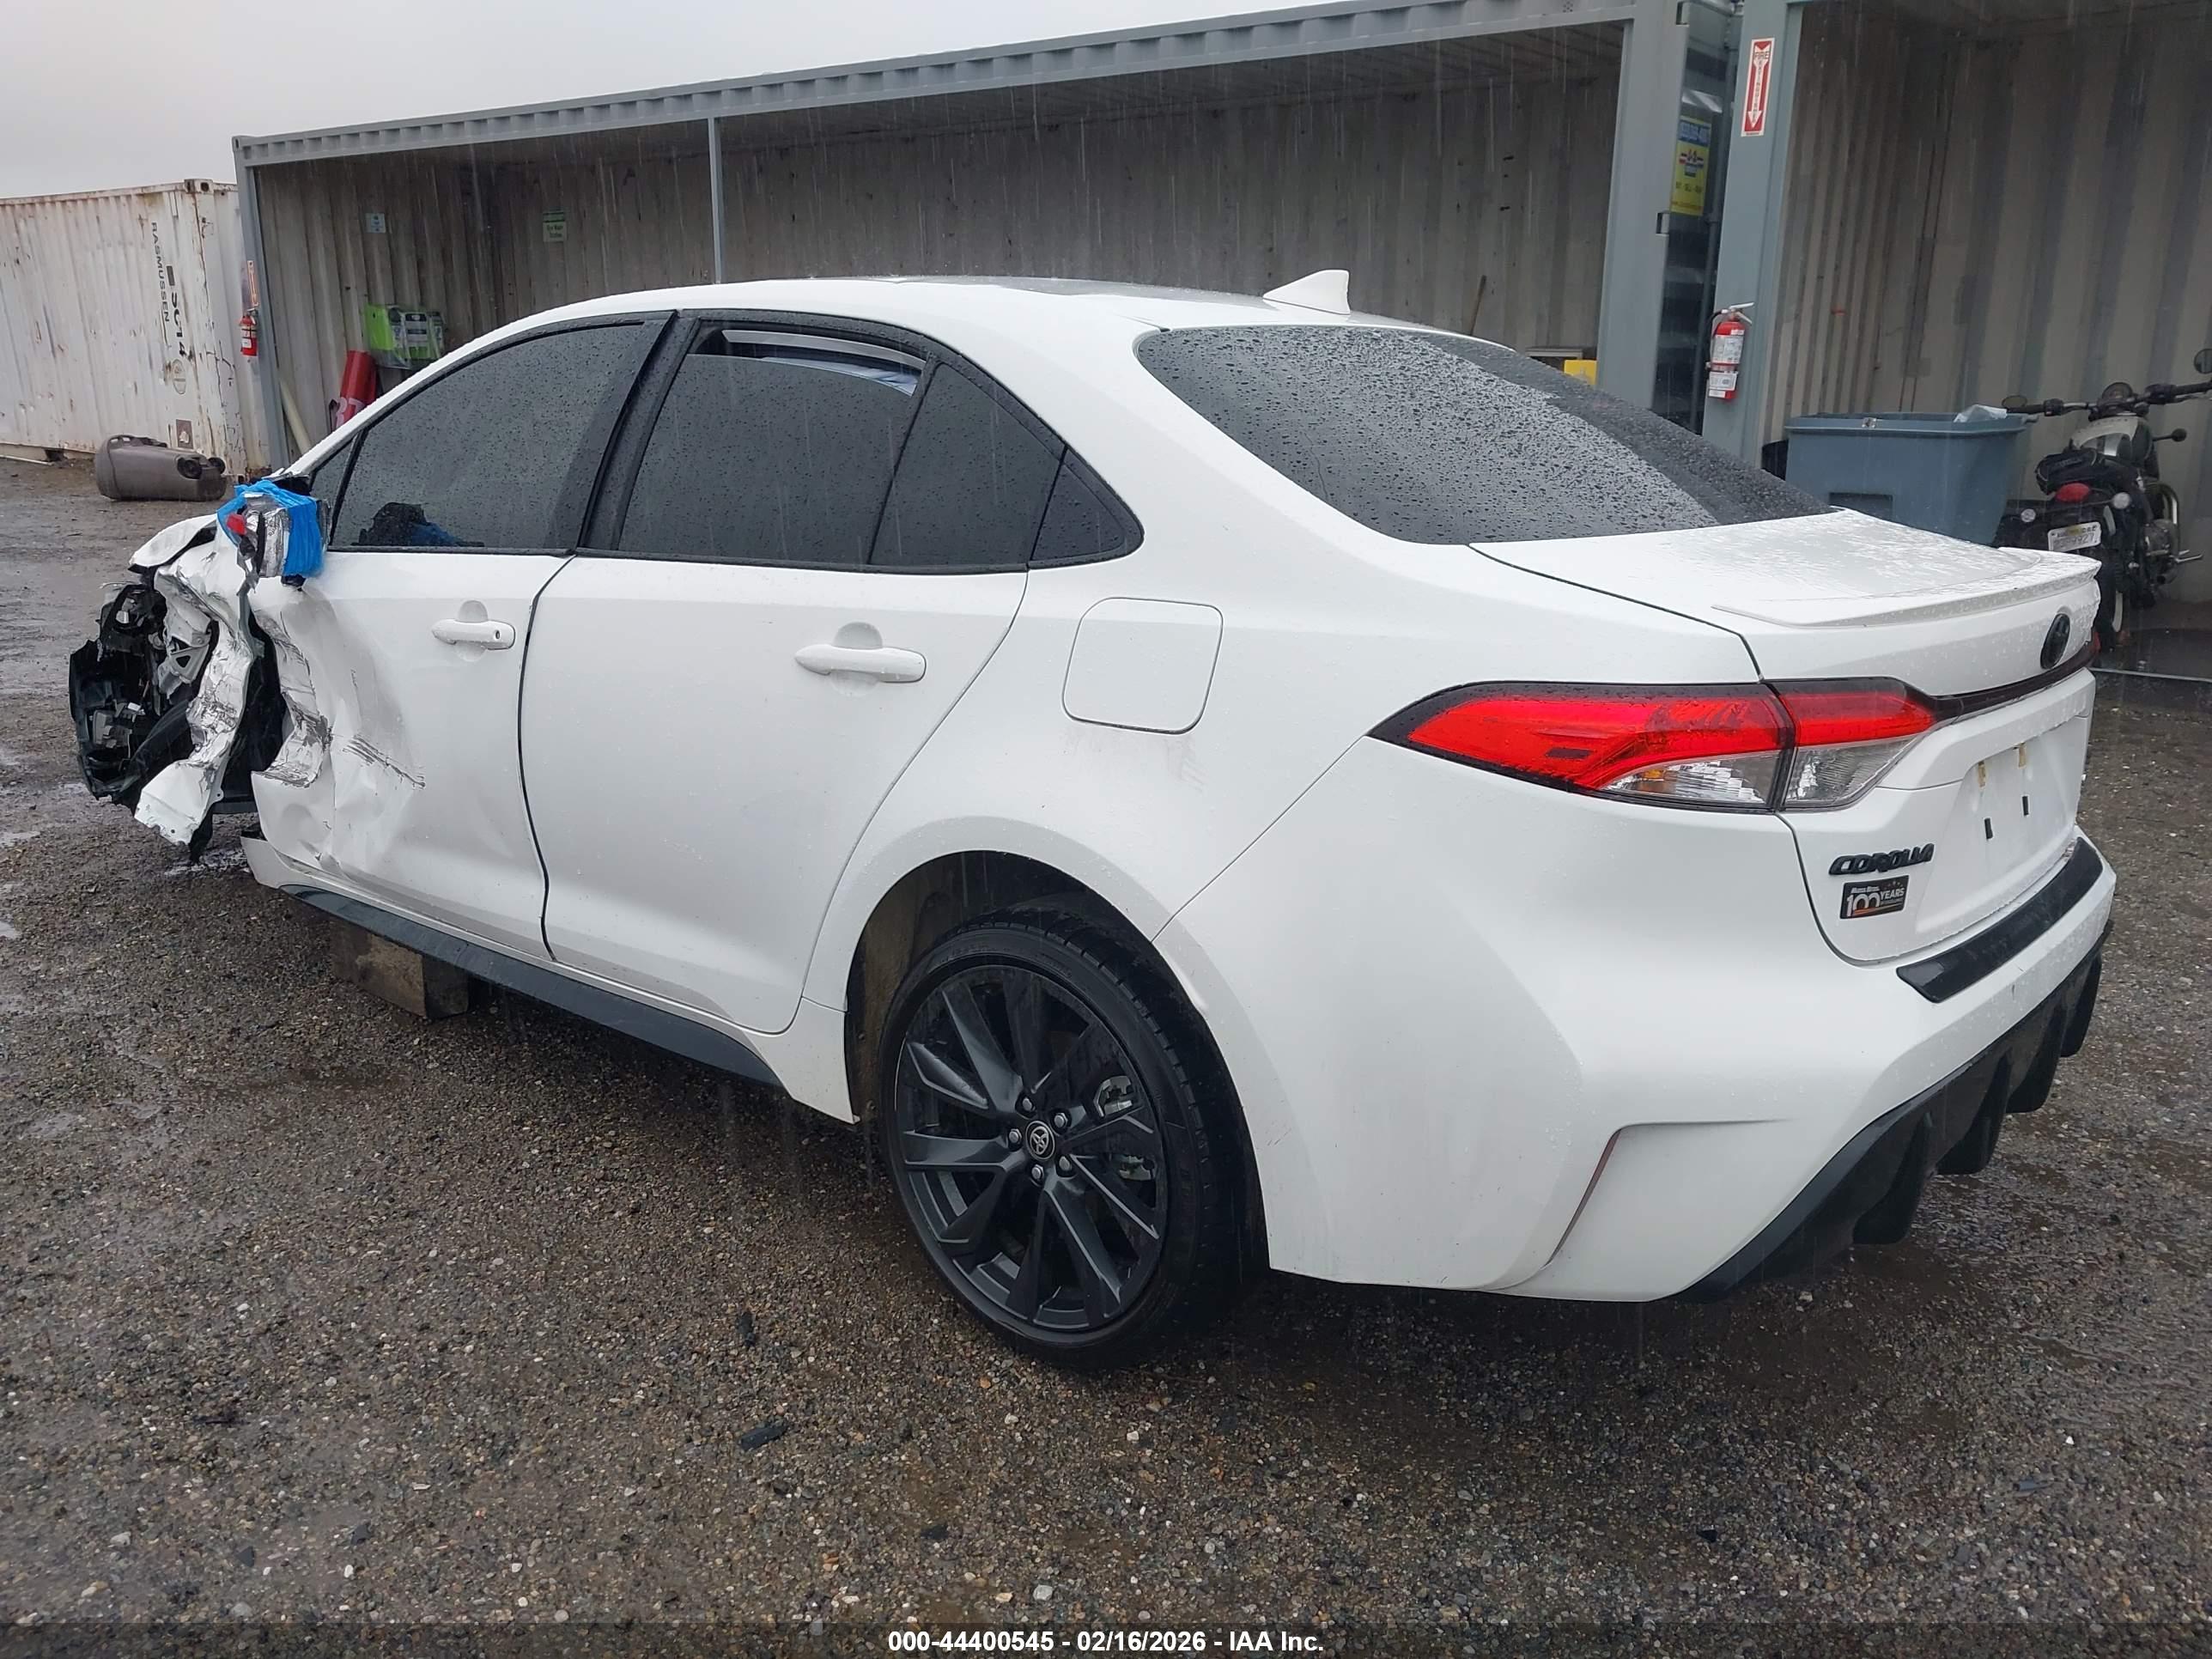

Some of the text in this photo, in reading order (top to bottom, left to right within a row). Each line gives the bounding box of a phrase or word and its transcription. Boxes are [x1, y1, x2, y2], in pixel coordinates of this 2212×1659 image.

[151, 222, 170, 322] RASMUSSEN
[1827, 842, 1936, 876] COROLLA
[1846, 892, 1881, 917] 100
[1881, 887, 1905, 901] YEARS
